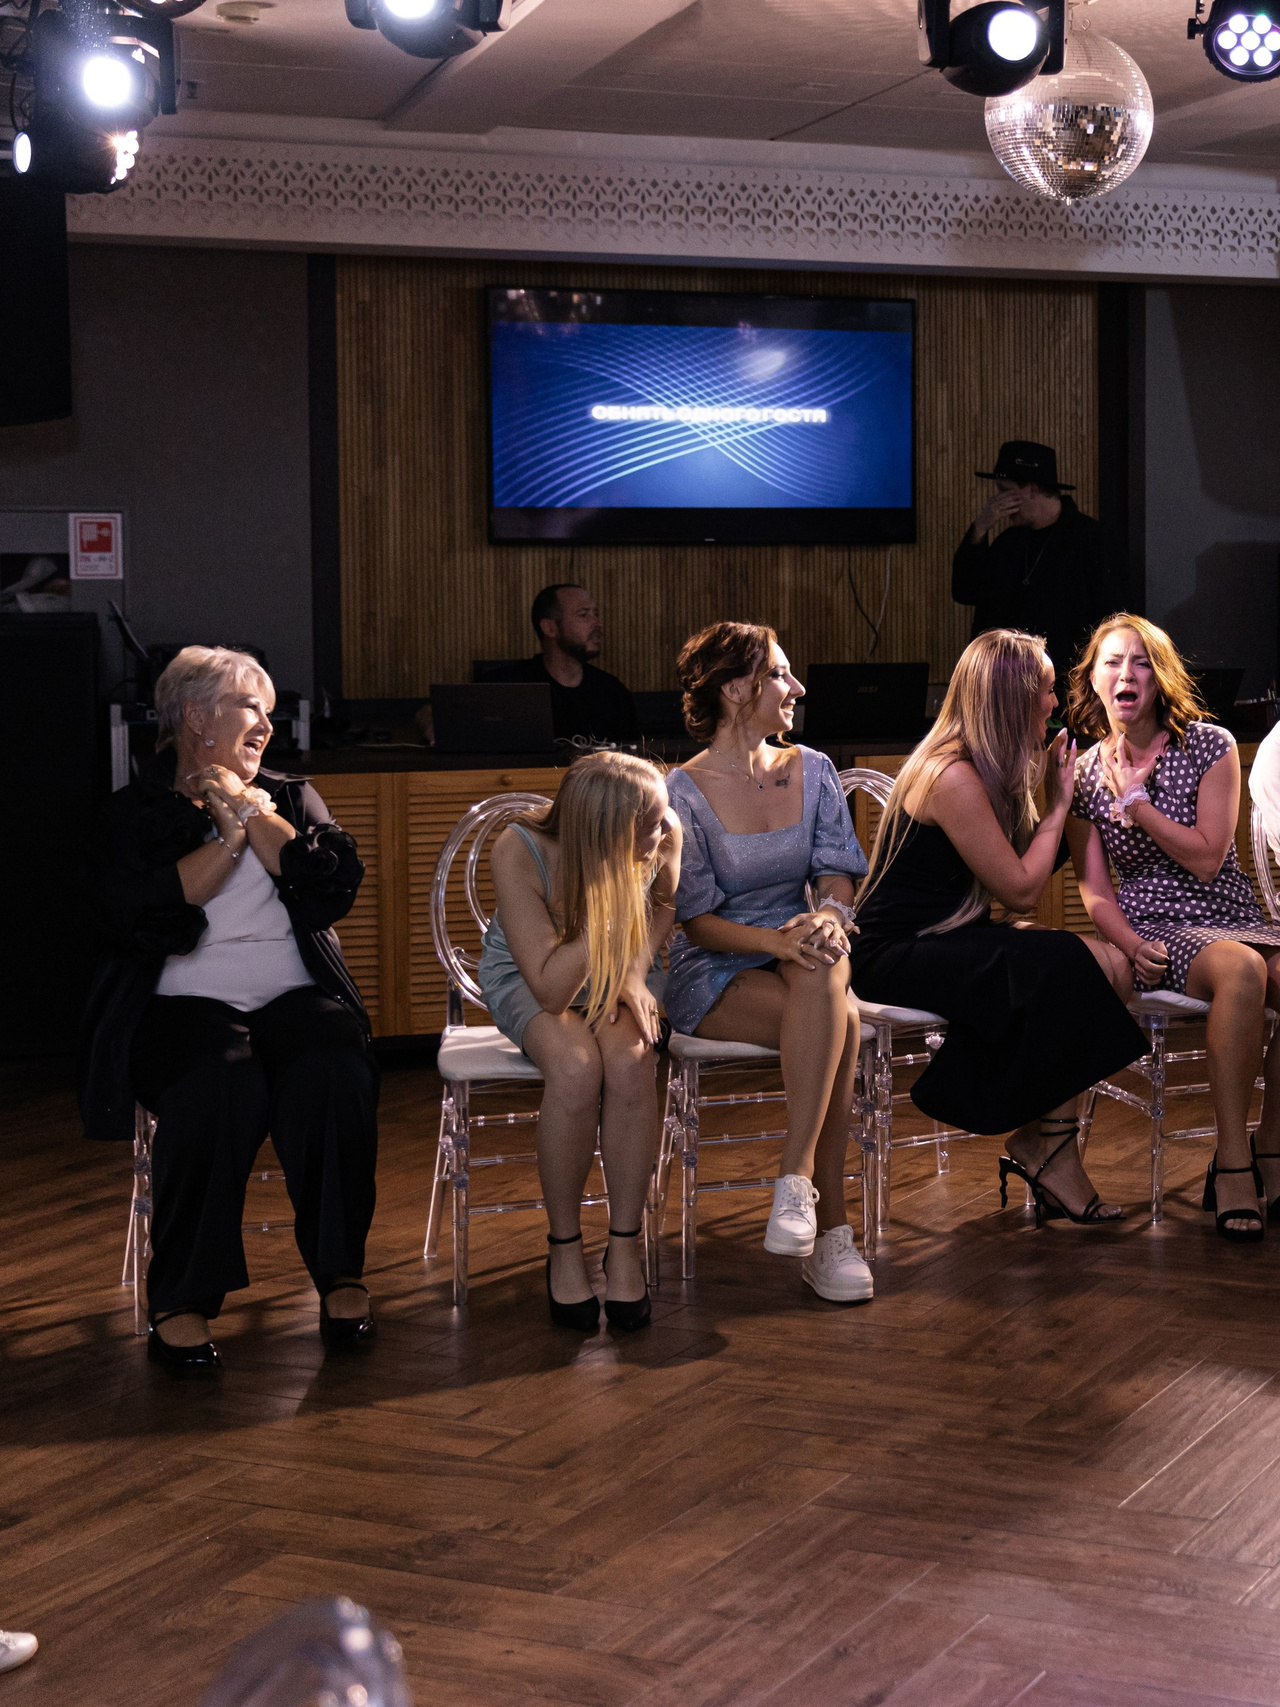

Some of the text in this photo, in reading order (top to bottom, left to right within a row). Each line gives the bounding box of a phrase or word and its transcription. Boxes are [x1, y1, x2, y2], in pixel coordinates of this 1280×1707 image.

[591, 405, 827, 423] ОБНЯТЬ ОДНОГО ГОСТЯ
